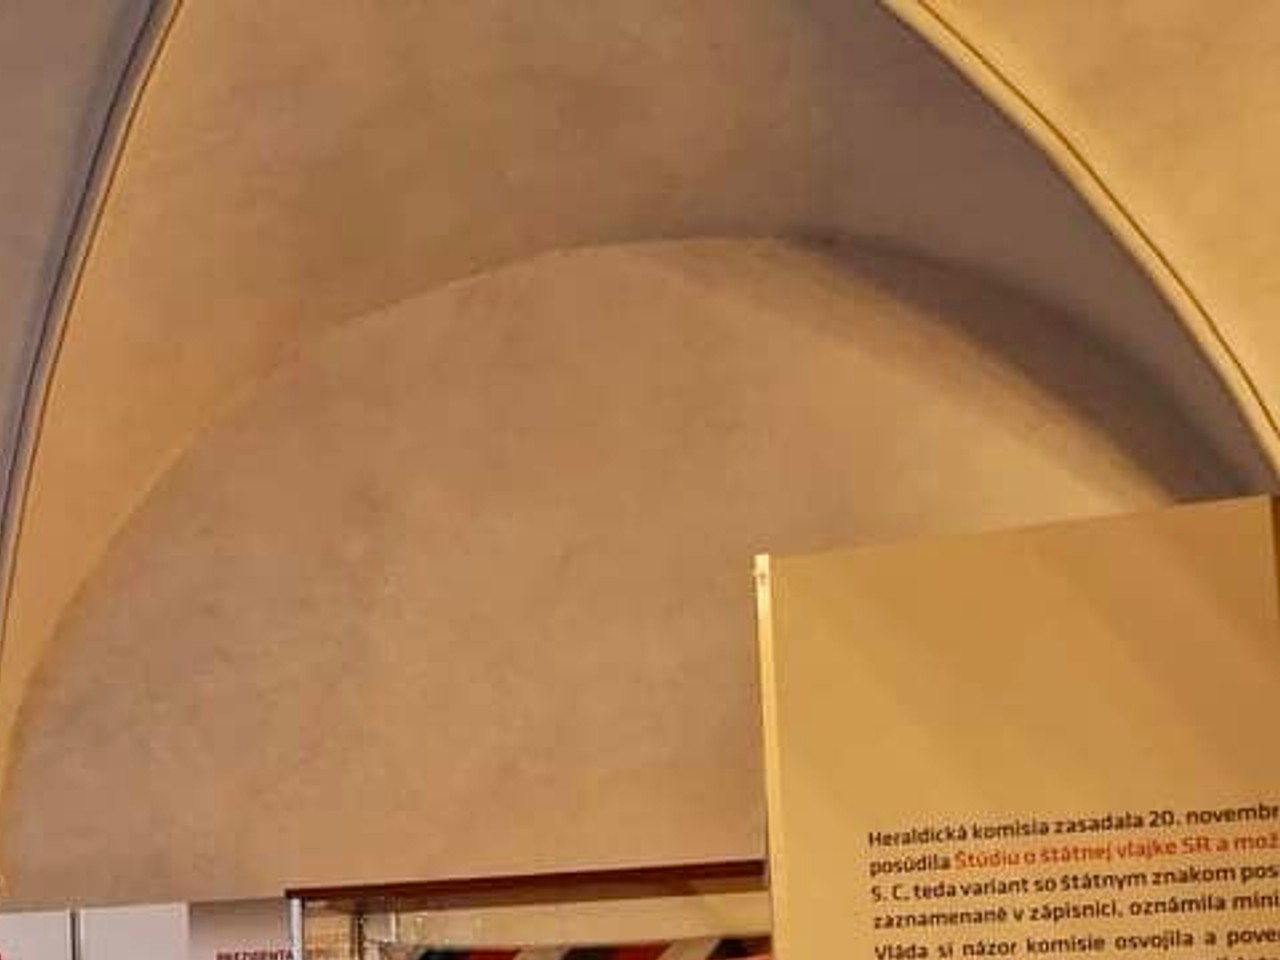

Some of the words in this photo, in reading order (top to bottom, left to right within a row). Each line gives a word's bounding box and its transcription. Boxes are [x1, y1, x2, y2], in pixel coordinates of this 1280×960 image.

[869, 825, 967, 847] Heraldická
[972, 817, 1050, 839] komisia
[1054, 811, 1144, 834] zasadala
[1149, 810, 1182, 828] 20.
[870, 854, 951, 877] posúdila
[1024, 851, 1036, 865] o
[1040, 842, 1111, 863] štátnej
[1118, 839, 1177, 860] vlajke
[1181, 835, 1210, 853] SR
[1216, 838, 1229, 852] a
[871, 885, 888, 902] S.
[914, 880, 956, 900] teda
[960, 877, 1028, 896] variant
[1033, 877, 1057, 893] so
[1060, 871, 1147, 892] štátnym
[1152, 865, 1236, 886] znakom
[1240, 864, 1279, 884] pos
[1013, 908, 1025, 922] v
[1129, 894, 1226, 916] oznámila
[875, 943, 929, 960] Vláda
[938, 942, 954, 958] si
[962, 939, 1018, 957] názor
[1026, 934, 1105, 954] komisie
[1115, 928, 1194, 951] osvojila
[1204, 931, 1217, 946] a
[1226, 928, 1280, 948] pove
